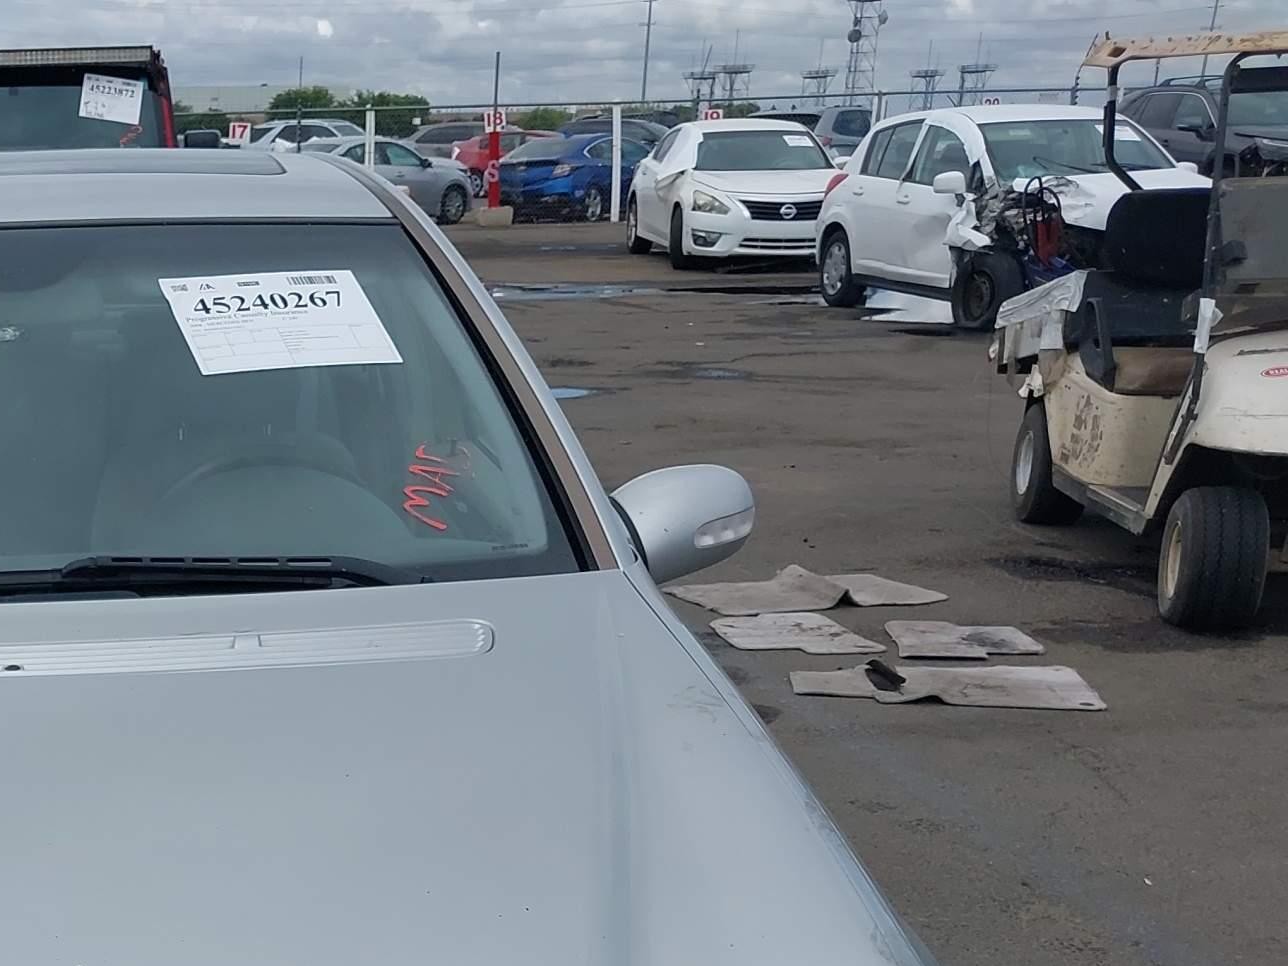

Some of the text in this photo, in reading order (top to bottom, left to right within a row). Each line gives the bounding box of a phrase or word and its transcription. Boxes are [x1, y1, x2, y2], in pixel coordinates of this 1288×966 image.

[487, 111, 503, 127] 18
[232, 124, 248, 139] 17
[193, 290, 341, 315] 45240267
